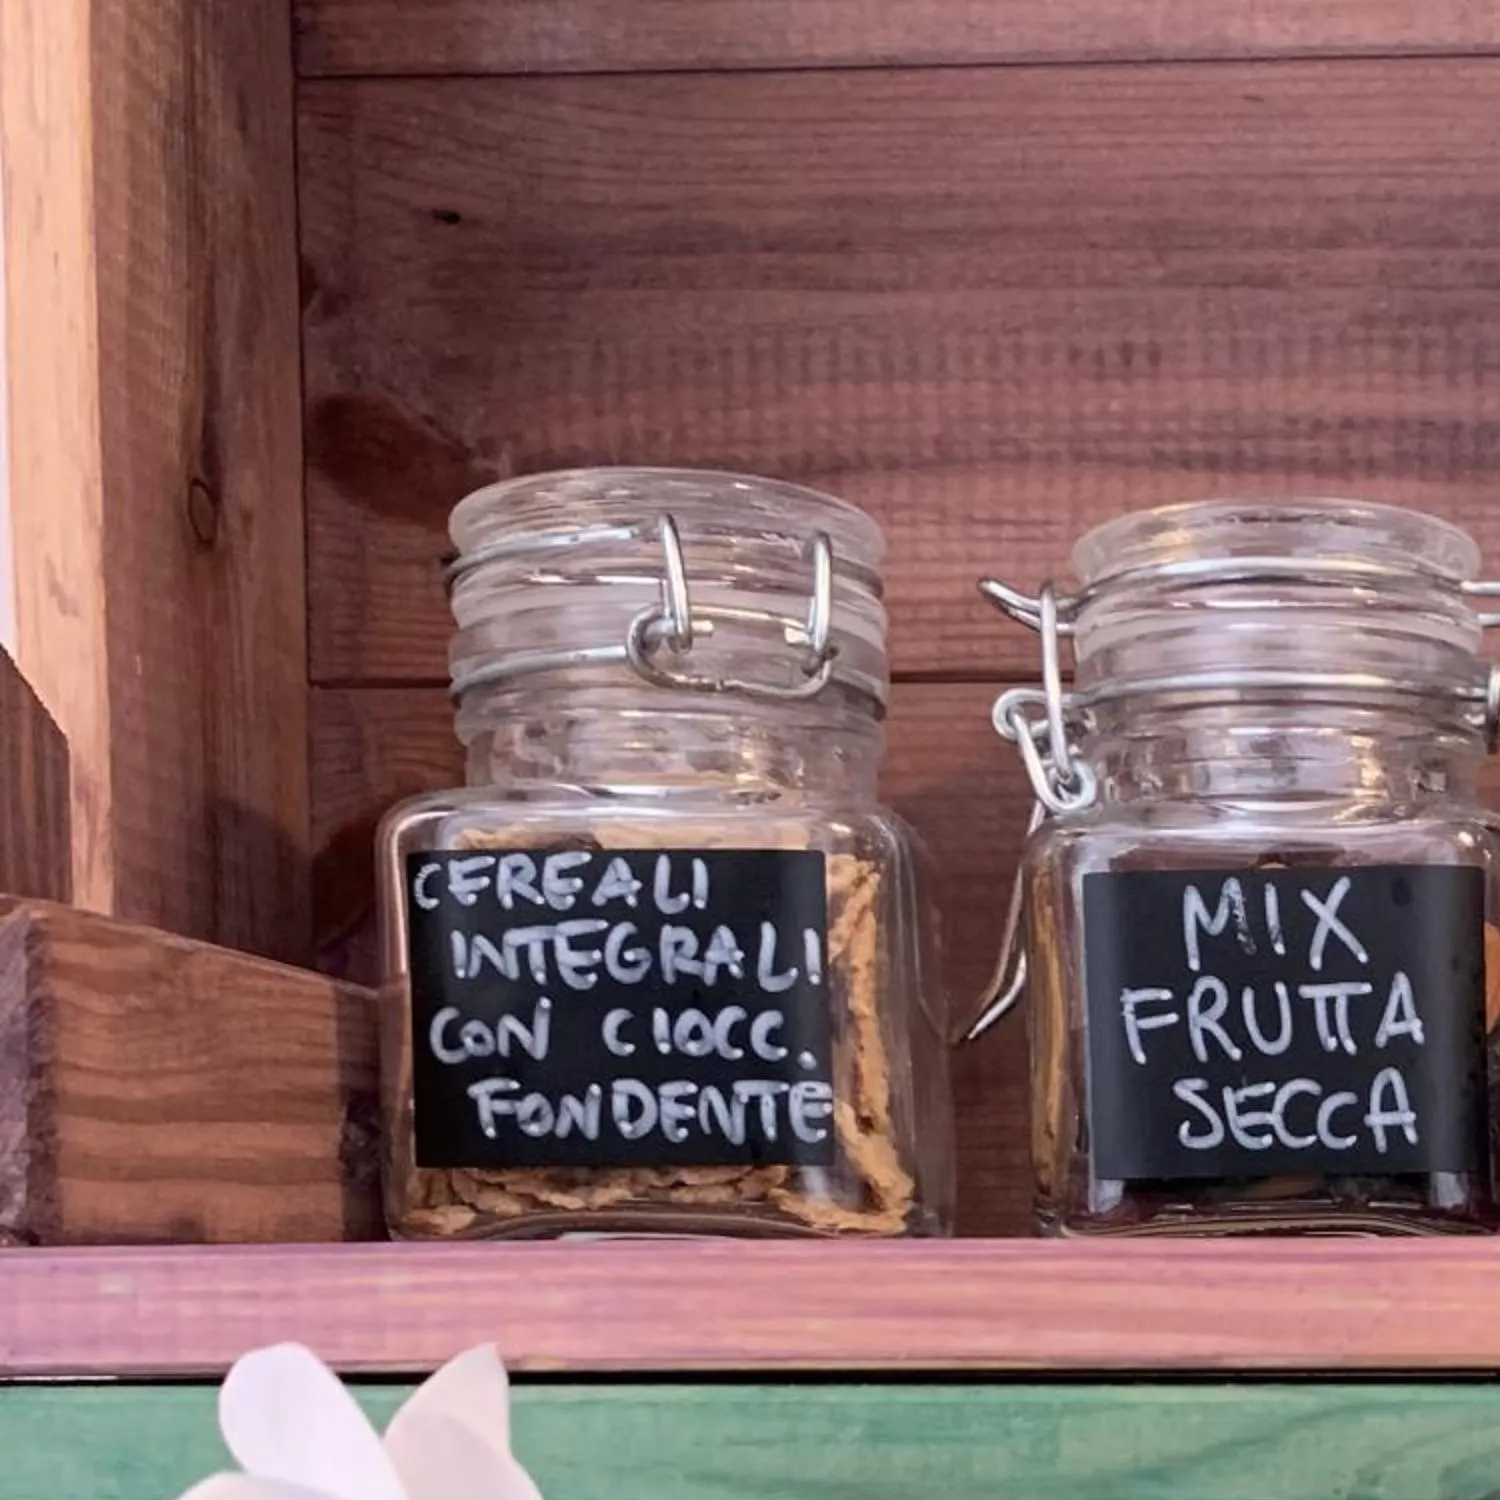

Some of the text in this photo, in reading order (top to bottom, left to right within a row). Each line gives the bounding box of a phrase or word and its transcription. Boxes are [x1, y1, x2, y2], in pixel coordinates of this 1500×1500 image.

[413, 851, 710, 912] CEREALI
[450, 920, 823, 992] INTEGRALI
[1183, 876, 1368, 970] MIX
[429, 997, 552, 1064] CON
[1119, 971, 1424, 1065] FRUTTA
[467, 1078, 833, 1143] FONDENTE
[1172, 1067, 1418, 1153] SECCA
